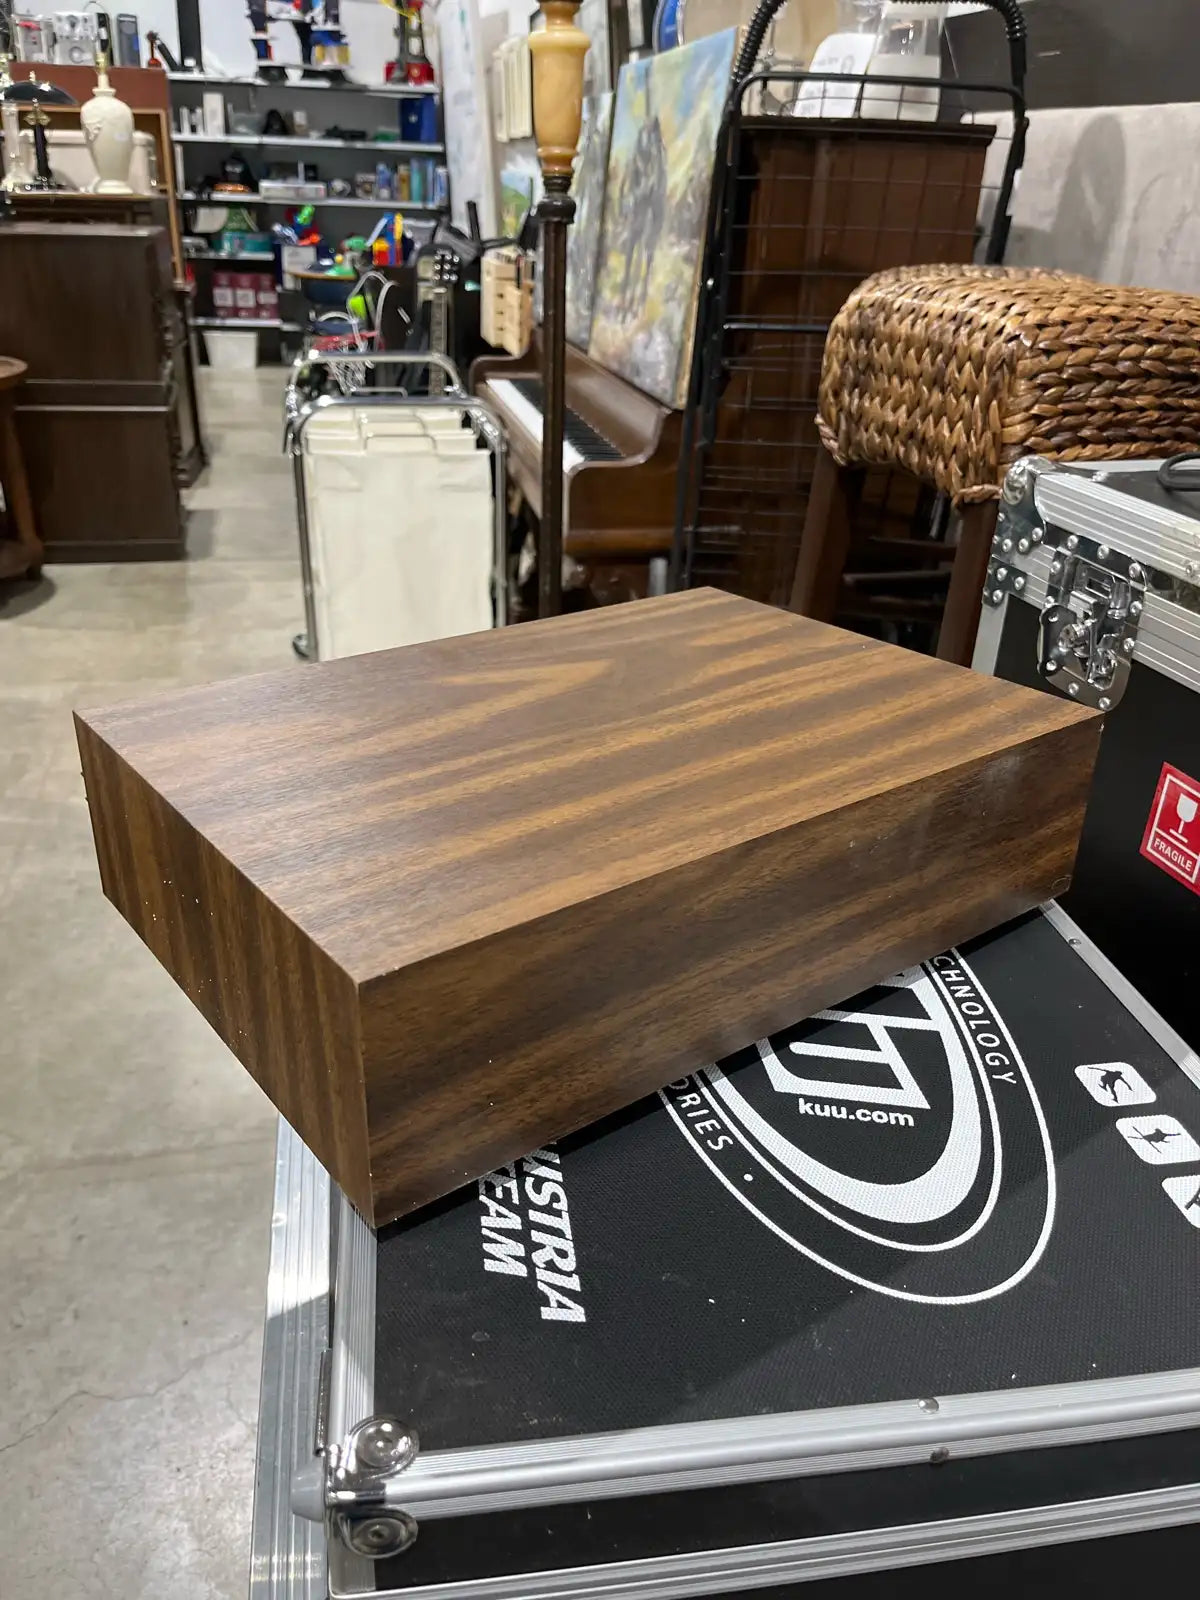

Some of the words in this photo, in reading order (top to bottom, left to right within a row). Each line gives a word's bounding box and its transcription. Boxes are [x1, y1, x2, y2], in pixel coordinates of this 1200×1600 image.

[1153, 838, 1193, 872] FRAGILE
[933, 955, 1017, 1084] CHNOLOGY
[798, 1097, 915, 1127] kuu.com
[525, 1142, 586, 1322] USTRIA
